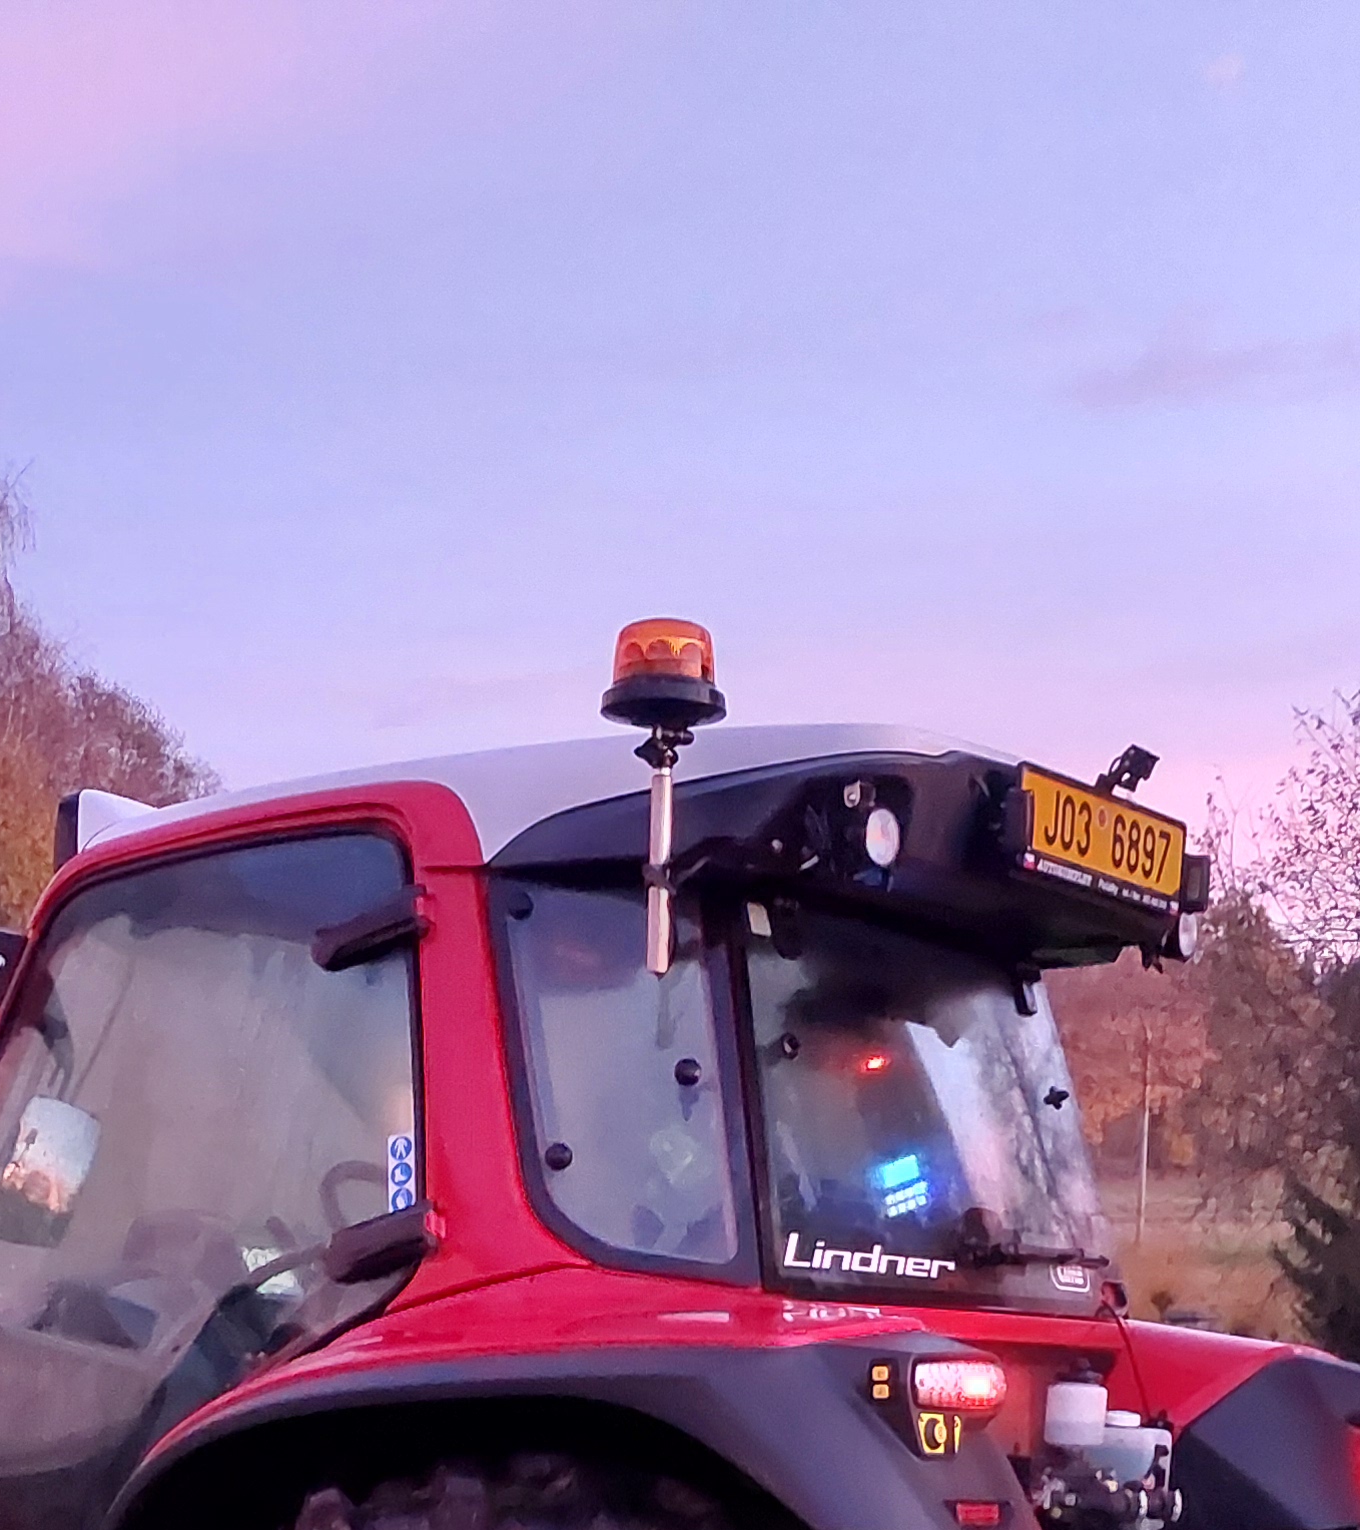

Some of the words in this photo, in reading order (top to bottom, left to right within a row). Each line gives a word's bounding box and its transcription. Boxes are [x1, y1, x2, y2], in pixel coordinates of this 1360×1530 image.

[1044, 790, 1092, 857] J03
[1111, 814, 1172, 884] 6897
[783, 1232, 956, 1279] Lindner
